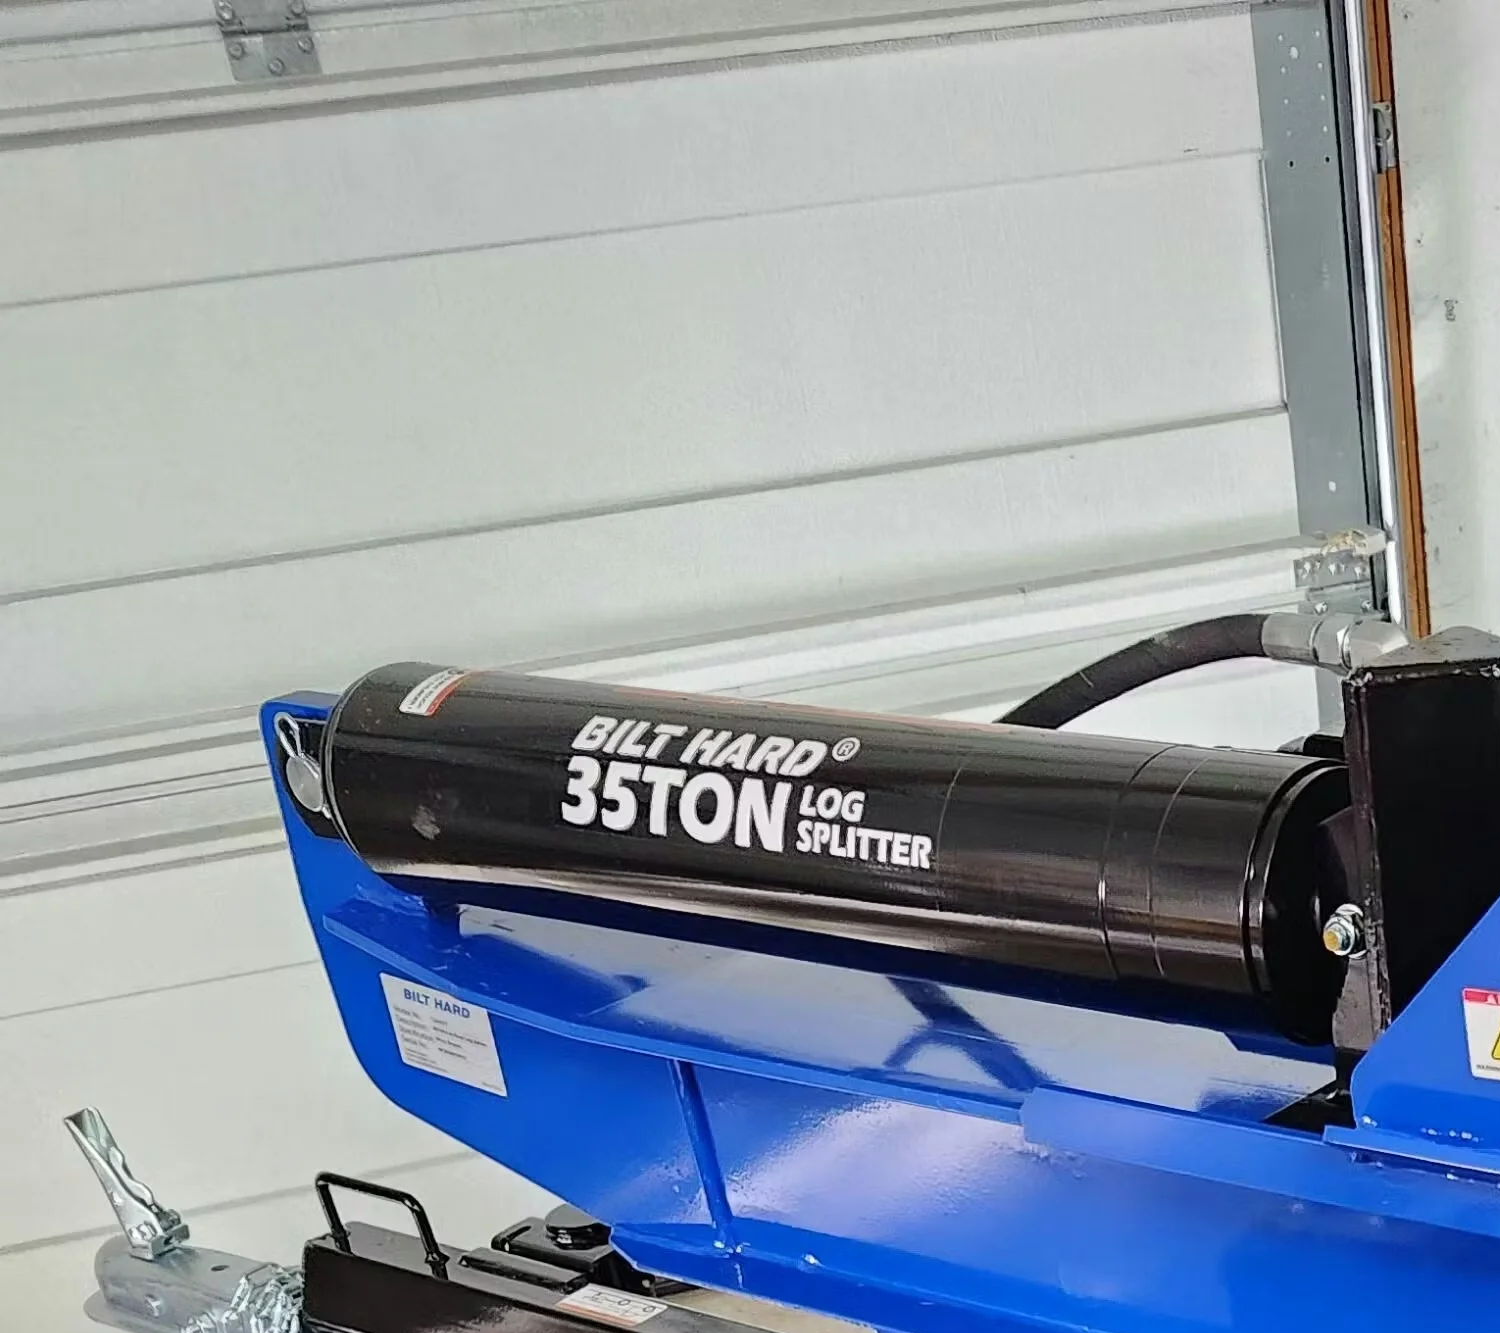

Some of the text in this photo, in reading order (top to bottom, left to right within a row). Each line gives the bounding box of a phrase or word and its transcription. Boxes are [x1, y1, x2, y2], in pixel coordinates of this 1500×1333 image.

[570, 715, 688, 760] BILT
[561, 755, 793, 853] 35TON
[798, 785, 866, 822] LOG
[795, 819, 934, 869] SPLITTER
[403, 988, 430, 1006] BILT
[434, 997, 471, 1019] HARD
